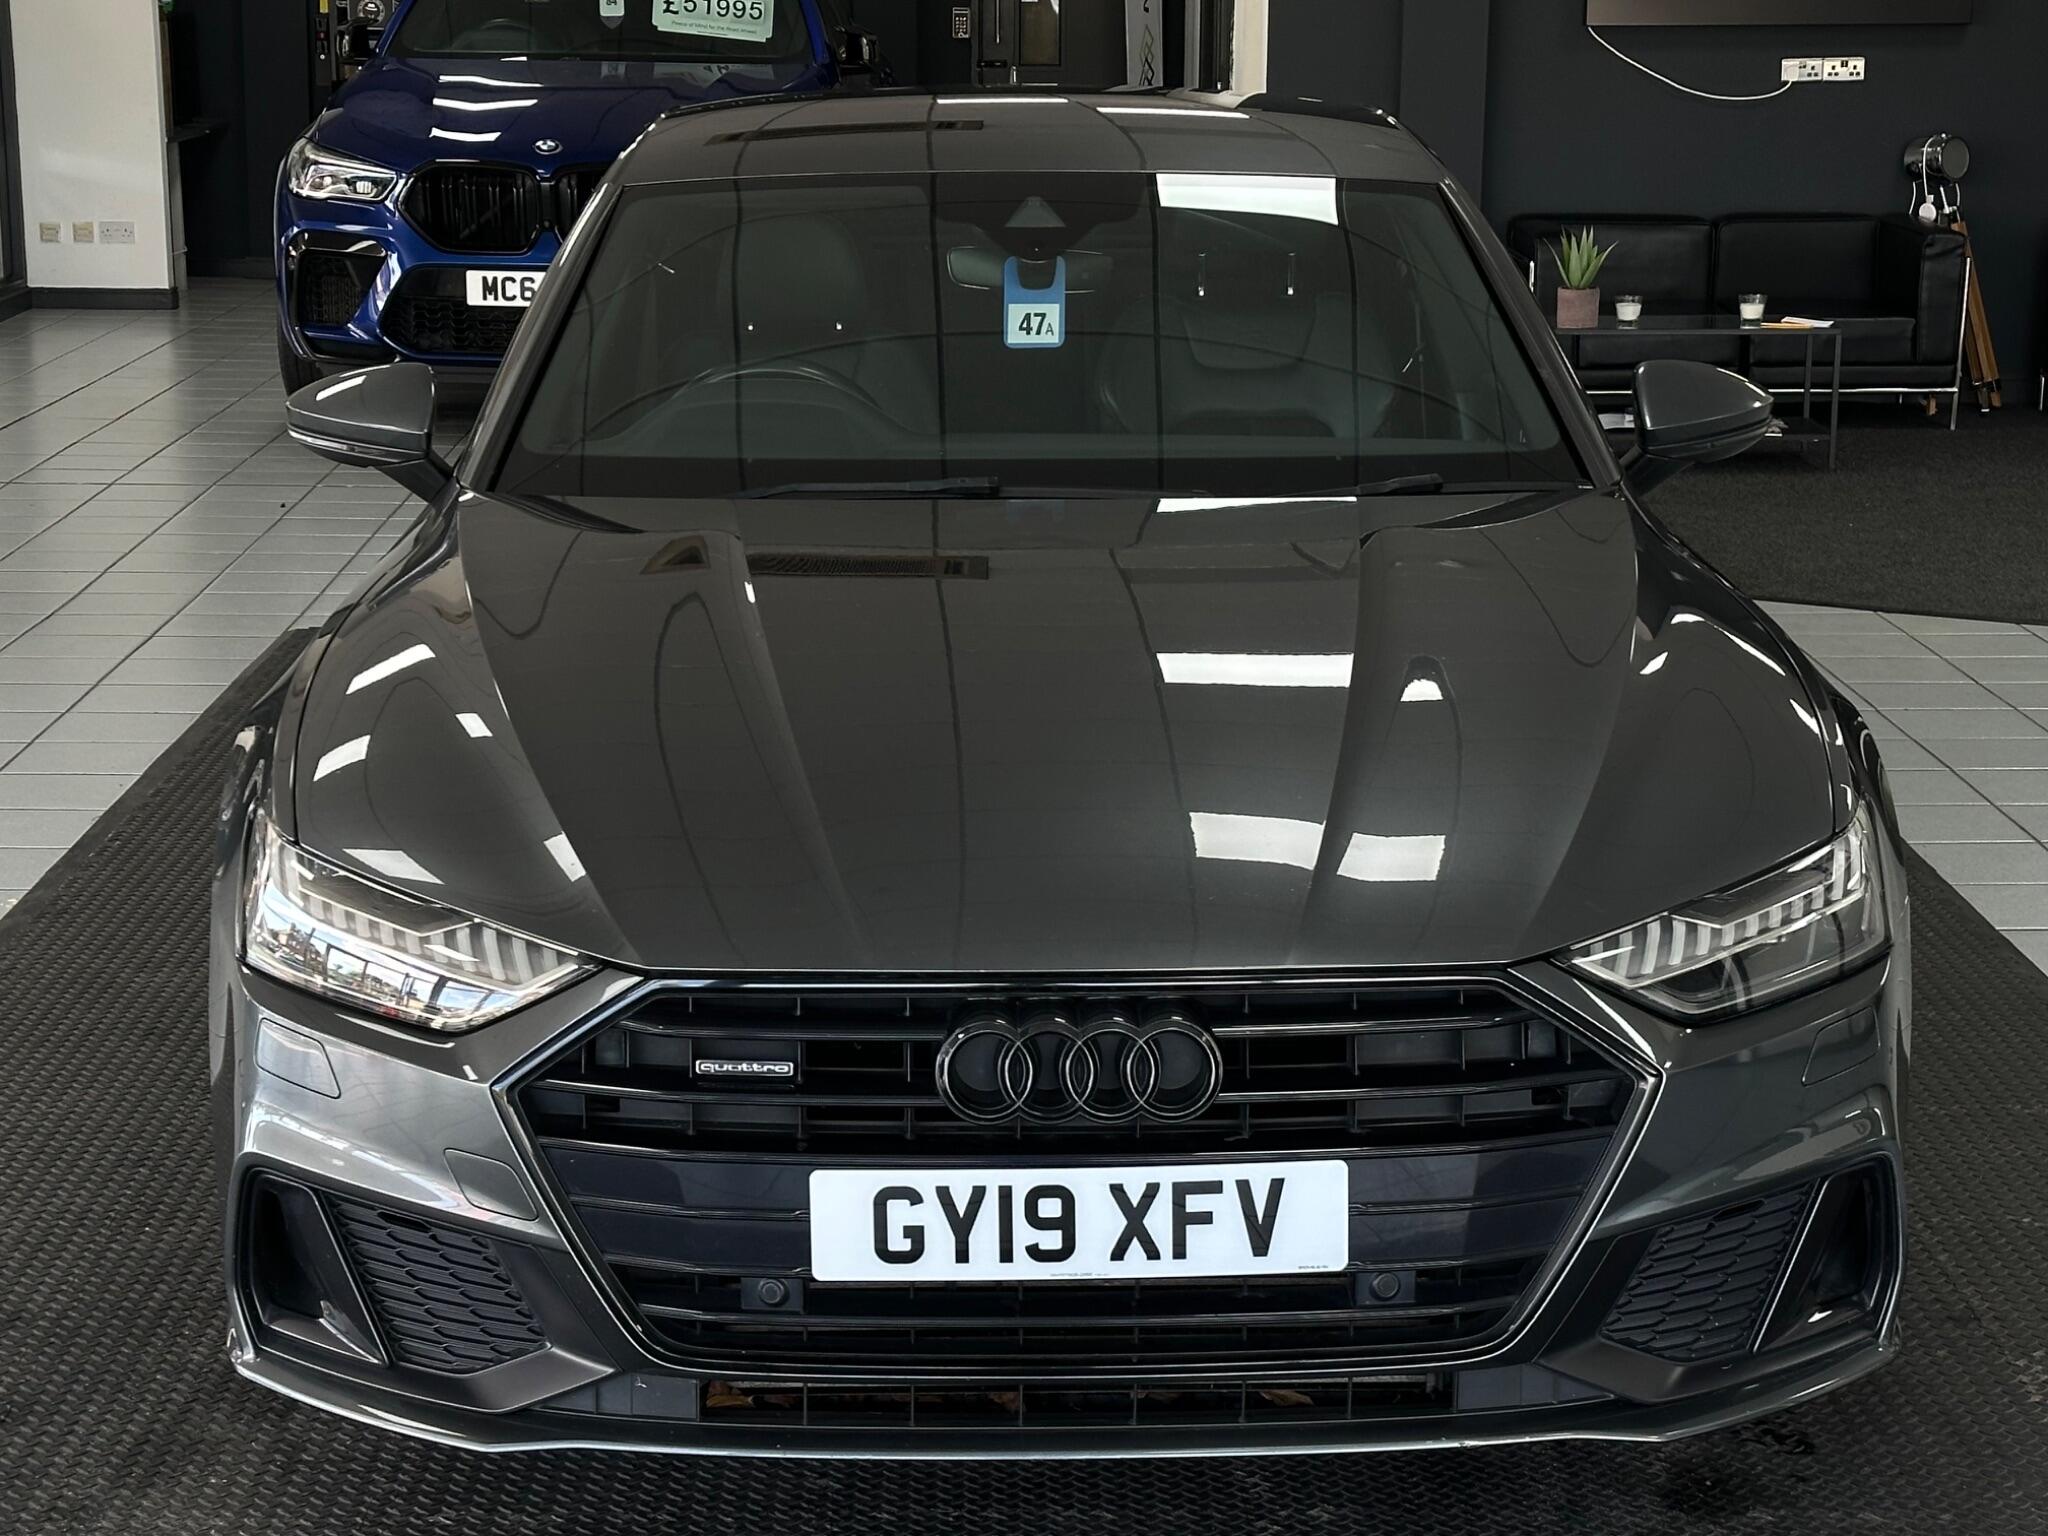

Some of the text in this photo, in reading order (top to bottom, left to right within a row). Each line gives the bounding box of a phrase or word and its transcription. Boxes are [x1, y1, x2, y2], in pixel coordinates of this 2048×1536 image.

[1018, 312, 1055, 336] 47A
[700, 1062, 790, 1073] quattro
[873, 1177, 1286, 1264] GY19 XFV
